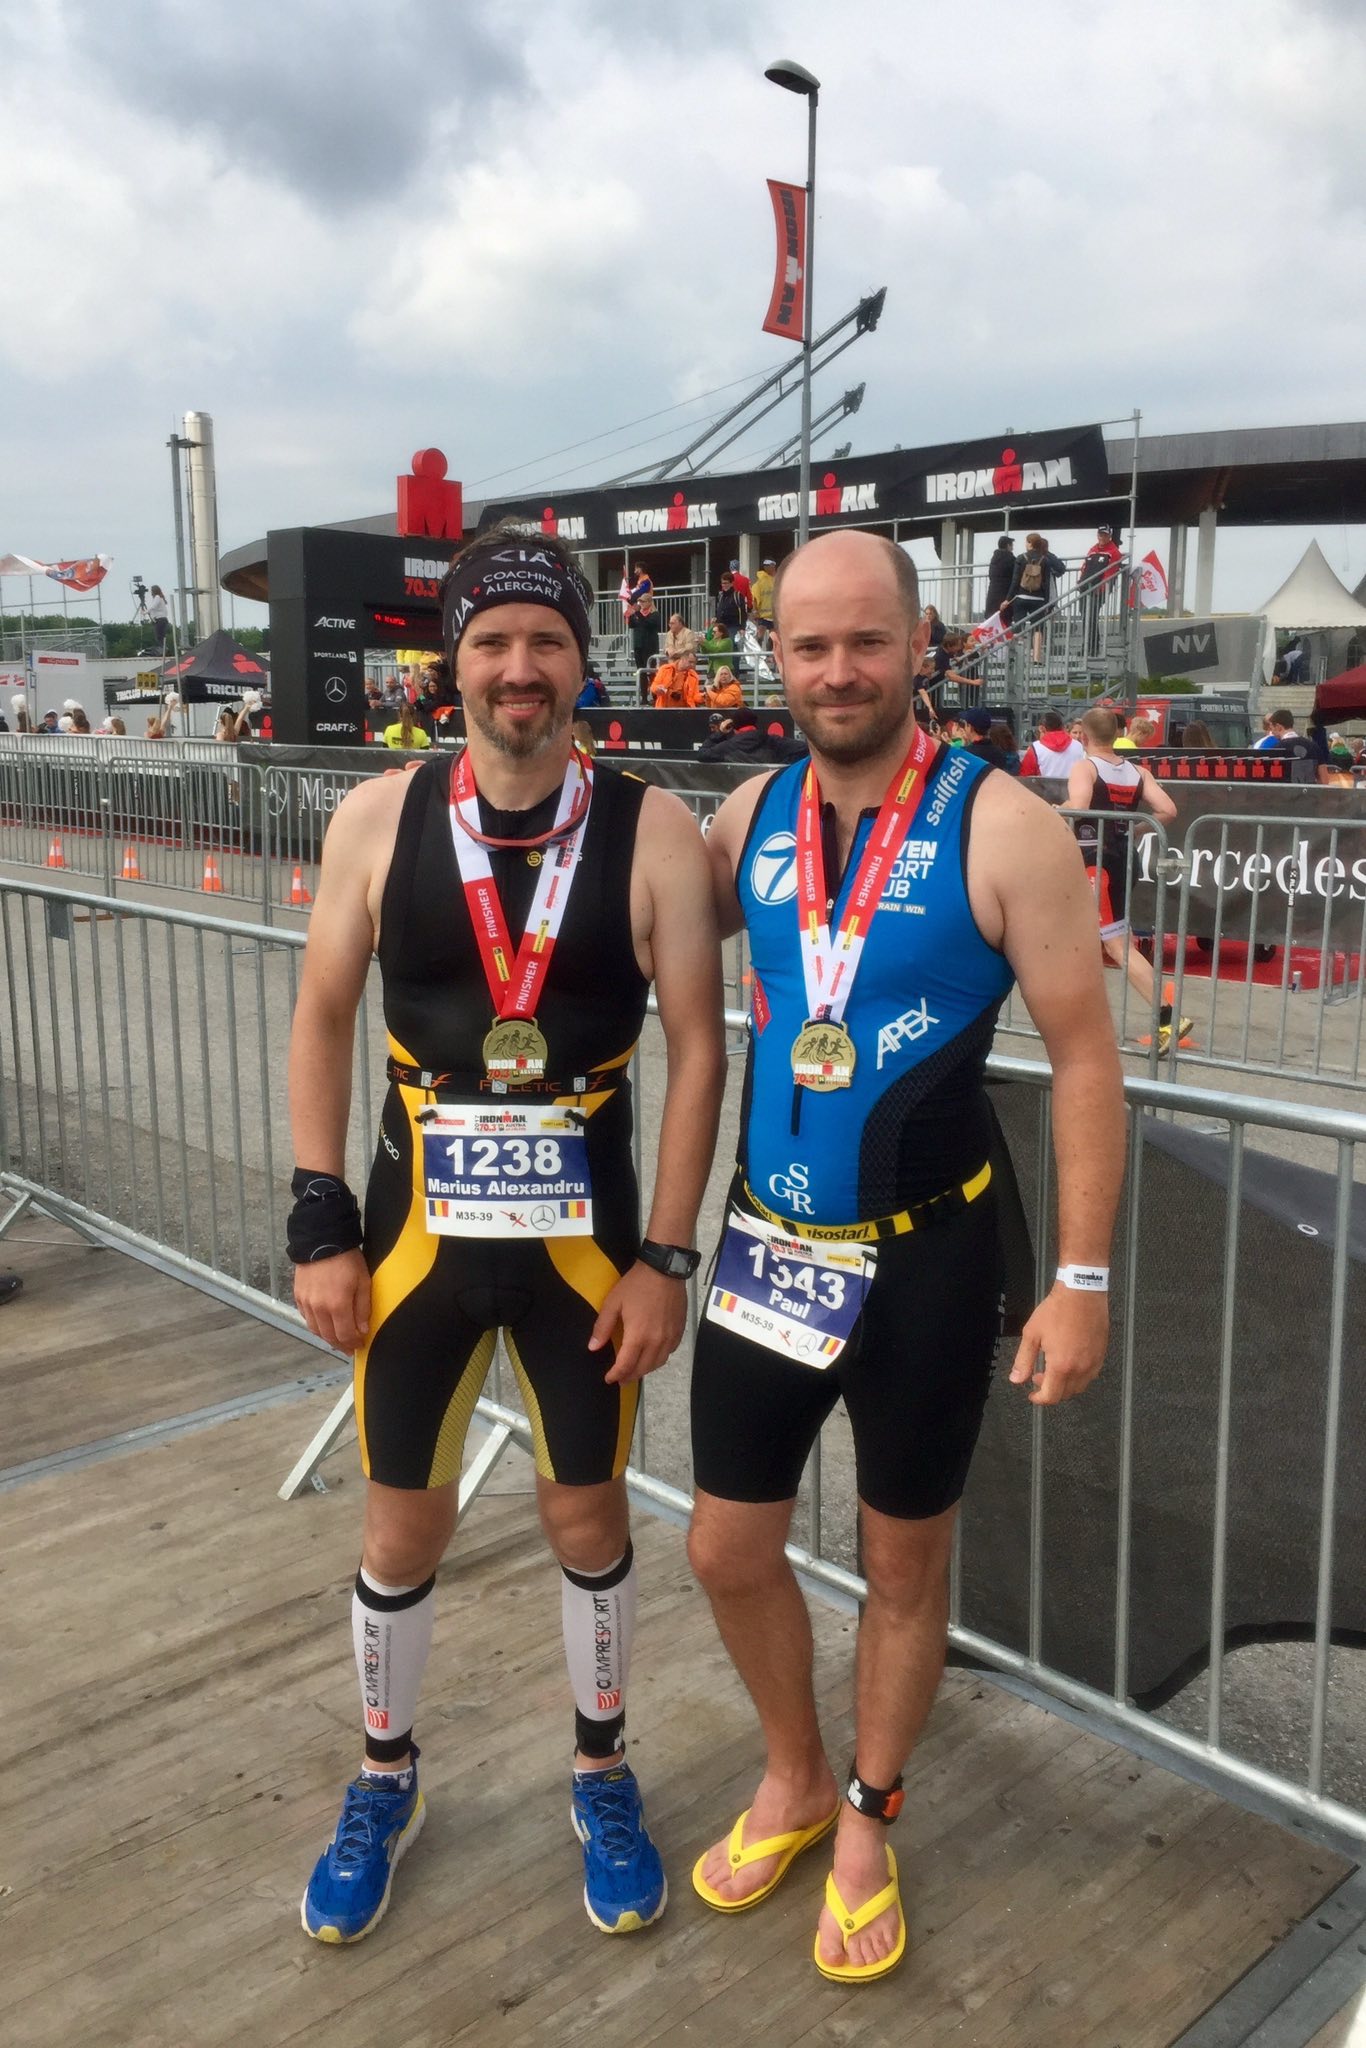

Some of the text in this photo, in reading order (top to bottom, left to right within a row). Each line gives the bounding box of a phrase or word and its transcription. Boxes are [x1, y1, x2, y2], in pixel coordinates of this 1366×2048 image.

[926, 448, 1073, 503] IRONMAN
[617, 491, 718, 535] IRONMAN
[483, 571, 562, 590] COACHING
[486, 581, 562, 602] ALERGARE
[314, 616, 356, 630] ACTIVE
[1172, 634, 1210, 654] NV
[316, 723, 349, 732] CRAFT
[926, 756, 970, 827] sailfish
[805, 850, 817, 902] FINISHER
[856, 856, 883, 908] FINISHER
[478, 888, 499, 938] FINISHER
[515, 960, 539, 1011] FINISHER
[876, 997, 940, 1070] APEX
[479, 1111, 526, 1123] IRONMAN
[446, 1138, 562, 1177] 1238
[428, 1178, 584, 1195] Marius Alexandru
[455, 1211, 493, 1221] M35-39
[770, 1238, 813, 1253] IRONMAN
[769, 1290, 810, 1320] Paul
[741, 1310, 774, 1331] M35-39
